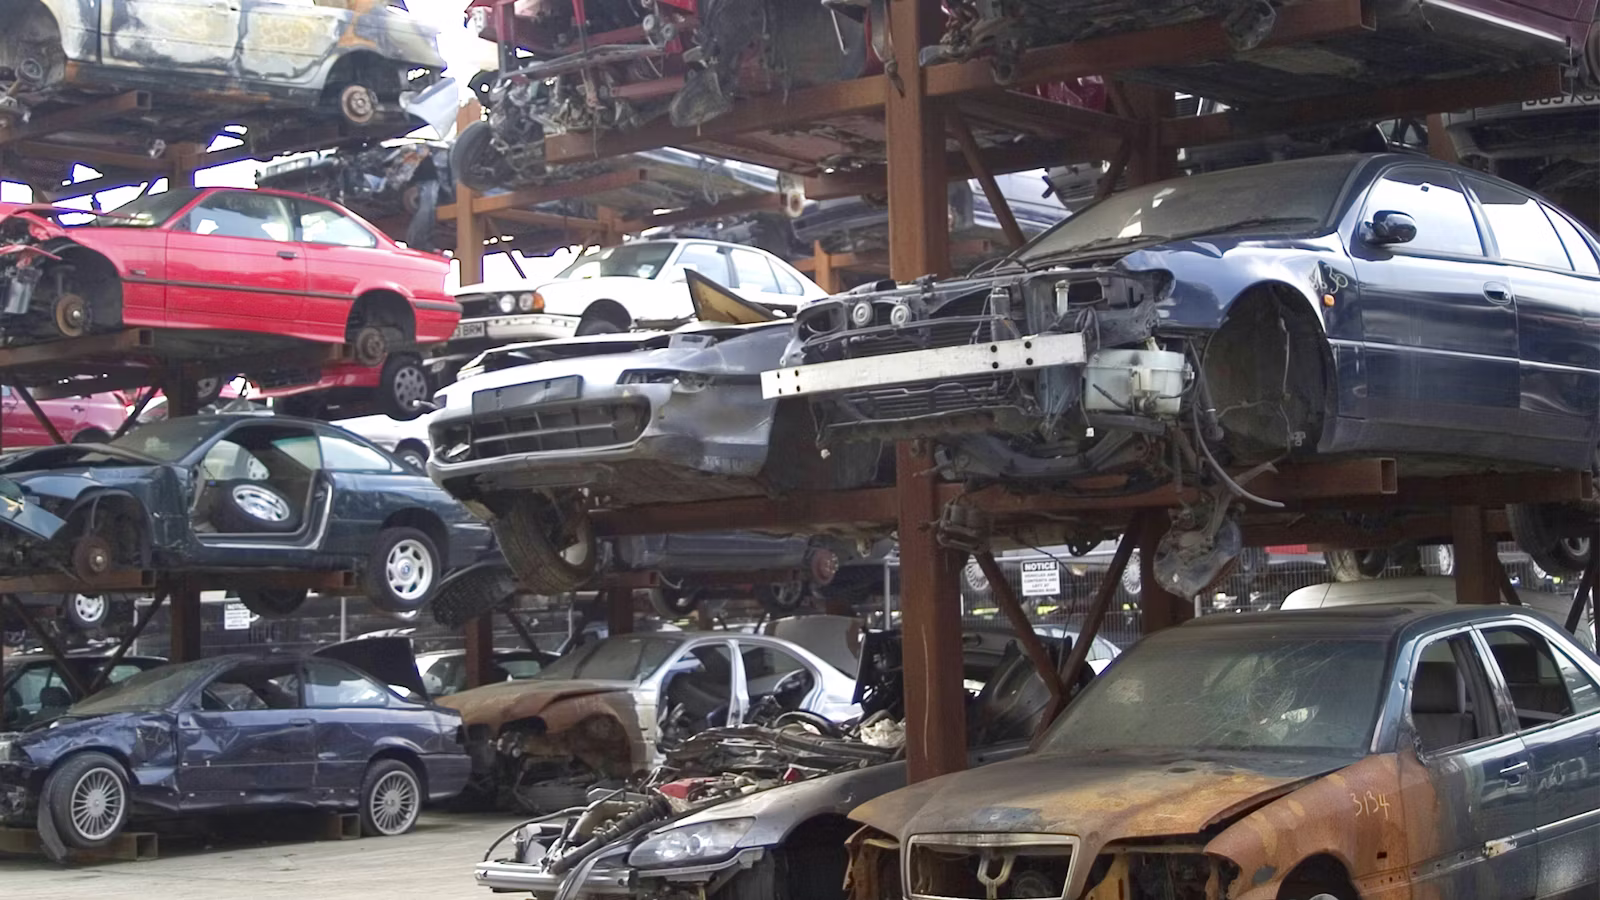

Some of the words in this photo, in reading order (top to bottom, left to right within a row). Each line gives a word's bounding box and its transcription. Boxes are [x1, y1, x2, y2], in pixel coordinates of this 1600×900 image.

[463, 324, 482, 336] BRM
[1024, 562, 1056, 571] NOTICE
[1350, 790, 1390, 820] 3134
